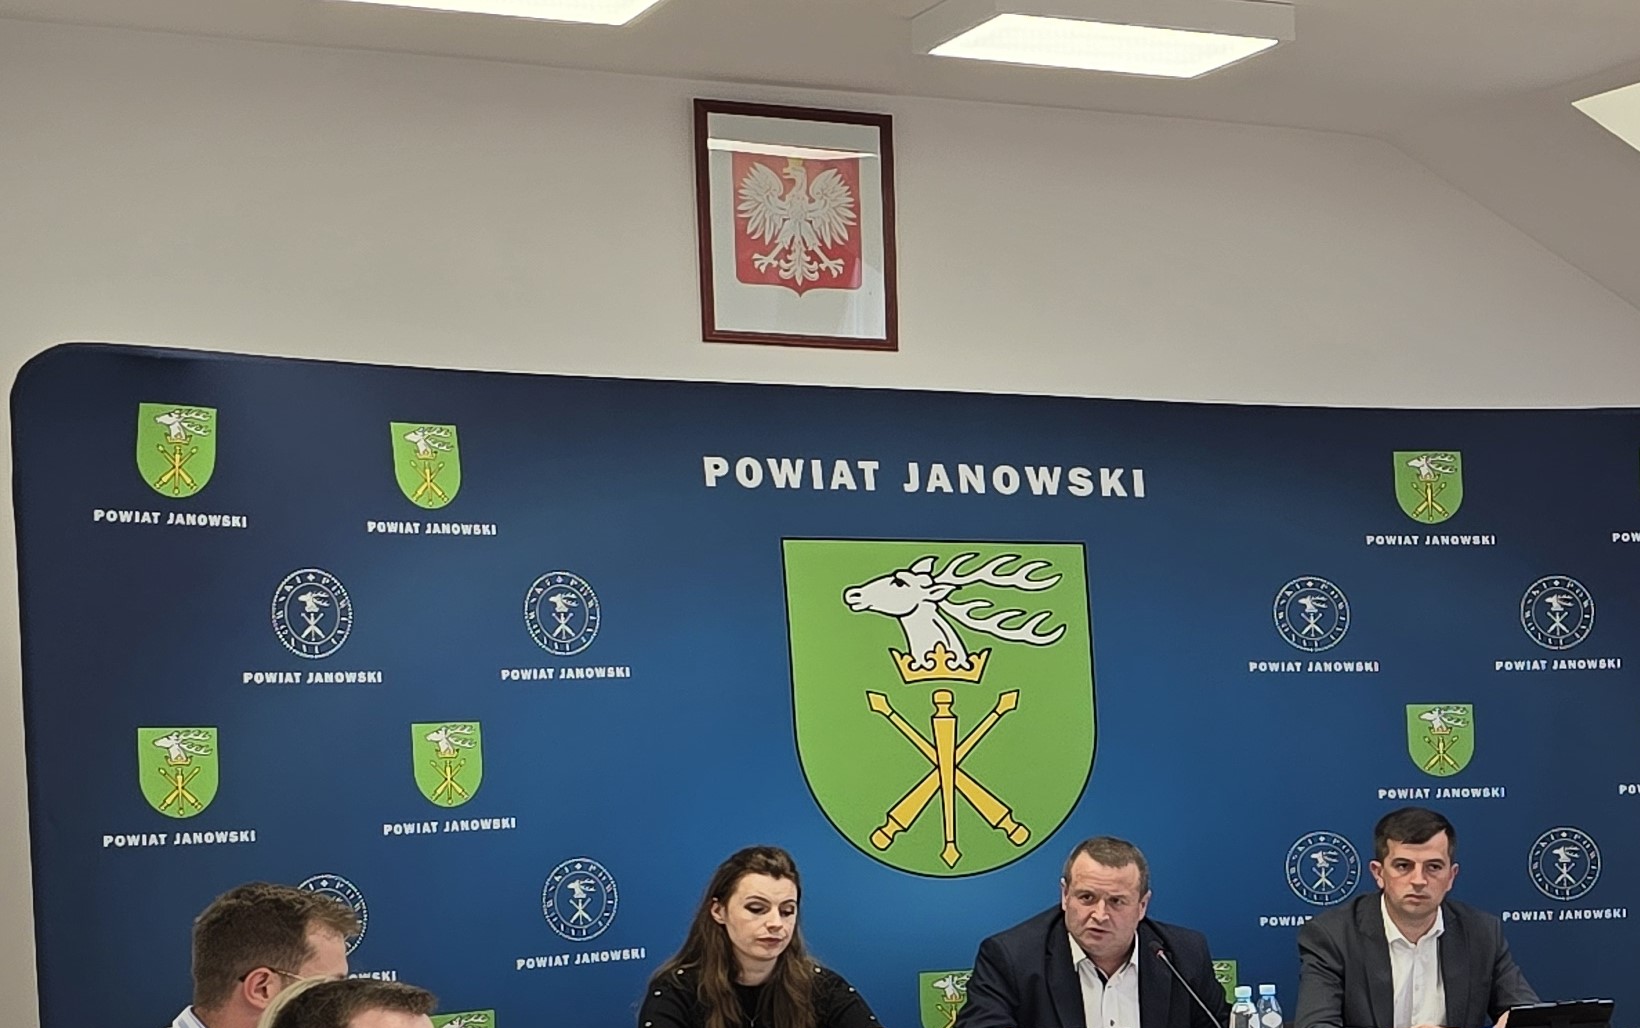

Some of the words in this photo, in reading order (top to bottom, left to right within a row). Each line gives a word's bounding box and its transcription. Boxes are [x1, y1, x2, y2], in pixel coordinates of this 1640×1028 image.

[702, 456, 880, 491] POWIAT
[903, 462, 1145, 498] JANOWSKI
[93, 509, 161, 525] POWIAT
[166, 512, 247, 529] JANOWSKI
[366, 520, 421, 534] POWIAT
[425, 522, 497, 536] JANOWSKI
[1365, 535, 1419, 546] POWIAT
[1424, 535, 1496, 546] JANOWSKI
[1248, 661, 1302, 672] POWIAT
[1307, 661, 1379, 672] JANOWSKI
[1495, 659, 1548, 671] POWIAT
[1552, 658, 1621, 670] JANOWSKI
[242, 672, 302, 685] POWIAT
[306, 671, 383, 684] JANOWSKI
[500, 668, 555, 681] POWIAT
[559, 666, 631, 679] JANOWSKI
[1377, 788, 1431, 799] POWIAT
[1435, 786, 1505, 799] JANOWSKI
[383, 821, 439, 836] POWIAT
[443, 817, 516, 833] JANOWSKI
[103, 833, 168, 848] POWIAT
[173, 829, 256, 845] JANOWSKI
[1502, 910, 1554, 922] POWIAT
[1558, 908, 1627, 921] JANOWSKI
[516, 954, 570, 971] POWIAT
[574, 947, 646, 965] JANOWSKI
